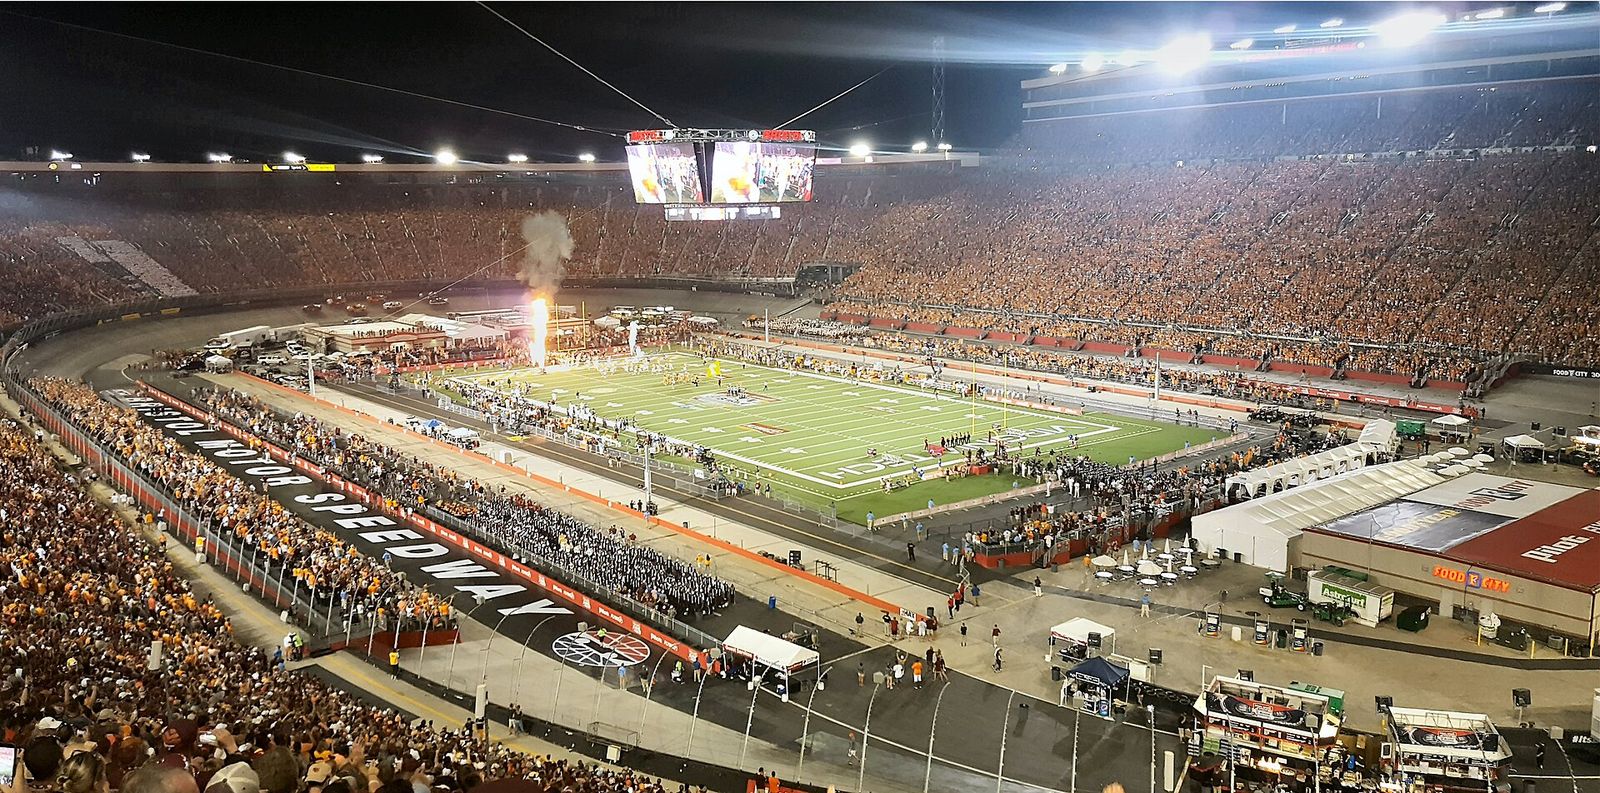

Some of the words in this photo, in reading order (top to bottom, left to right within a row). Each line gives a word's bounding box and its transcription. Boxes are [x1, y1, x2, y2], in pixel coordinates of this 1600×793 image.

[194, 439, 313, 487] MOTOR
[294, 493, 575, 616] SPEEDWAY
[1433, 566, 1467, 584] FOOD
[1481, 576, 1511, 593] CITY
